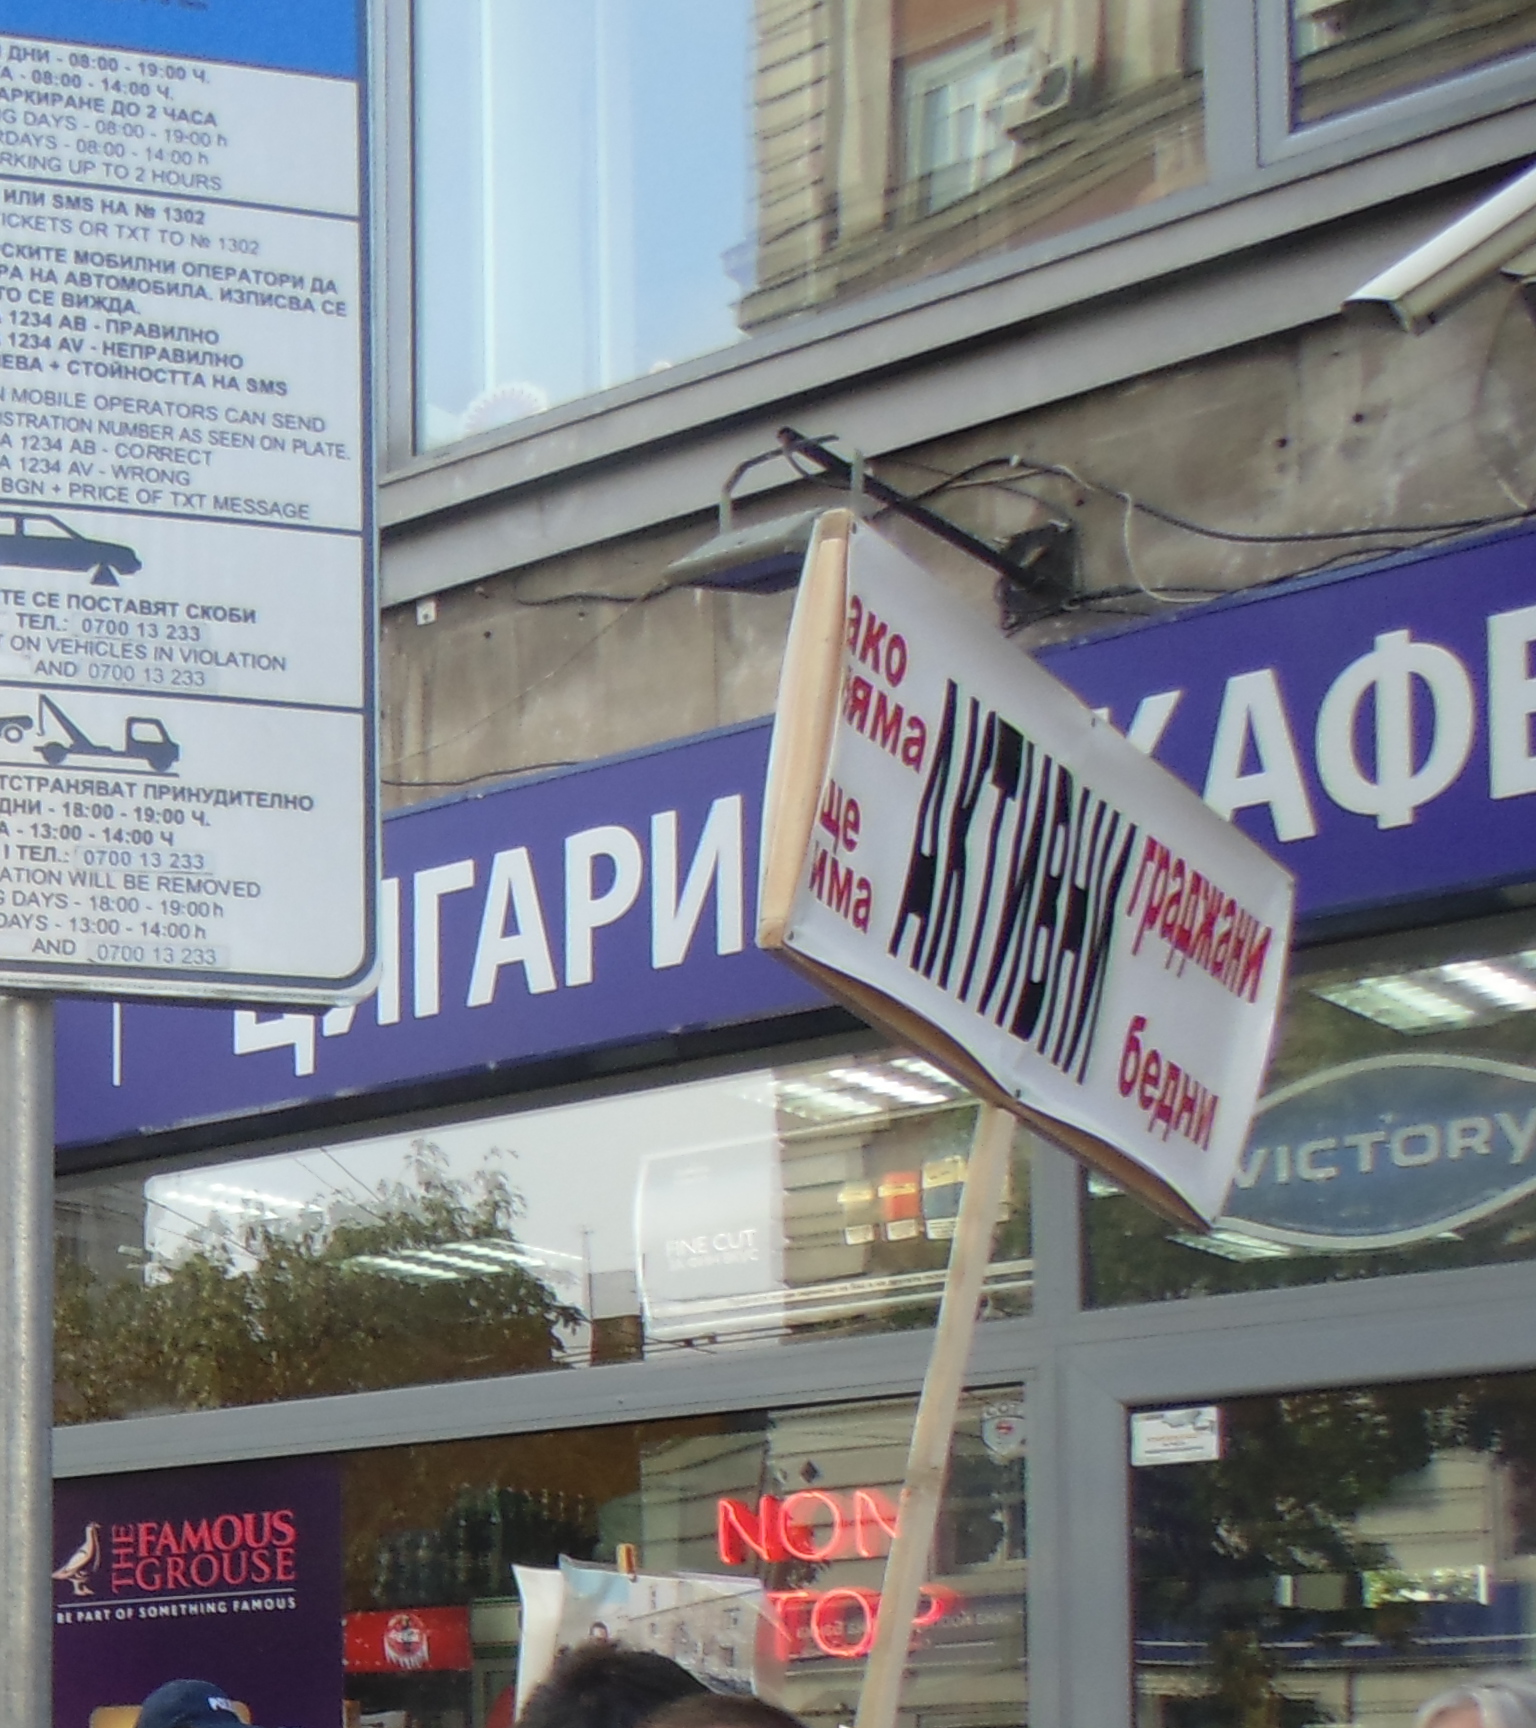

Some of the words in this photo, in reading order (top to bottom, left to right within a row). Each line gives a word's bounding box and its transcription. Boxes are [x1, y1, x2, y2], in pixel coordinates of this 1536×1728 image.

[110, 99, 142, 119] ДО
[146, 103, 158, 120] 2
[162, 106, 218, 128] ЧАСА
[68, 158, 97, 176] UP
[101, 161, 130, 181] TO
[134, 166, 147, 183] 2
[151, 168, 223, 192] HOURS
[3, 188, 46, 207] ИЛИ
[51, 192, 95, 213] SMS
[99, 198, 130, 217] НА
[162, 205, 206, 226] 1302
[78, 219, 109, 239] OR
[114, 223, 151, 243] TXT
[157, 228, 186, 247] TO
[73, 248, 176, 275] МОБИЛНИ
[181, 260, 305, 291] ОПЕРАТОРИ
[309, 276, 339, 296] ДА
[29, 266, 59, 286] НА
[63, 270, 214, 302] АВТОМОБИЛА.
[219, 286, 316, 313] ИЗПИСВА
[320, 299, 347, 318] СЕ
[10, 387, 87, 410] MOBILE
[93, 393, 219, 423] OPERATORS
[224, 406, 267, 427] CAN
[271, 411, 327, 434] SEND
[31, 590, 61, 610] СЕ
[66, 592, 180, 618] ПОСТАВЯТ
[185, 602, 257, 625] СКОБИ
[81, 617, 130, 637] 0700
[136, 621, 159, 639] 13
[165, 623, 201, 643] 233
[9, 633, 42, 657] ON
[45, 636, 148, 661] VEHICLES
[153, 645, 174, 663] IN
[178, 646, 287, 672] VIOLATION
[33, 659, 80, 679] AND
[88, 662, 136, 683] 0700
[143, 666, 165, 685] 13
[170, 667, 206, 688] 233
[843, 664, 928, 773] яма
[142, 782, 315, 812] ПРИНУДИТЕЛНО
[83, 849, 132, 867] 0700
[139, 851, 162, 869] 13
[169, 852, 205, 871] 233
[67, 867, 117, 890] WILL
[122, 870, 151, 892] BE
[156, 874, 262, 899] REMOVED
[888, 679, 1138, 1084] АКТИВНИ
[30, 936, 77, 957] AND
[96, 943, 145, 962] 0700
[153, 946, 175, 964] 13
[181, 947, 216, 966] 233
[1117, 1014, 1220, 1152] бедни
[1233, 1107, 1536, 1190] VICTORY
[718, 1488, 912, 1566] NON
[110, 1524, 136, 1594] THE
[136, 1509, 298, 1557] FAMOUS
[134, 1548, 298, 1592] GROUSE
[56, 1612, 74, 1625] BE
[77, 1608, 111, 1623] PART
[114, 1607, 134, 1620] OF
[137, 1600, 228, 1620] SOMETHING
[232, 1595, 298, 1613] FAMOUS
